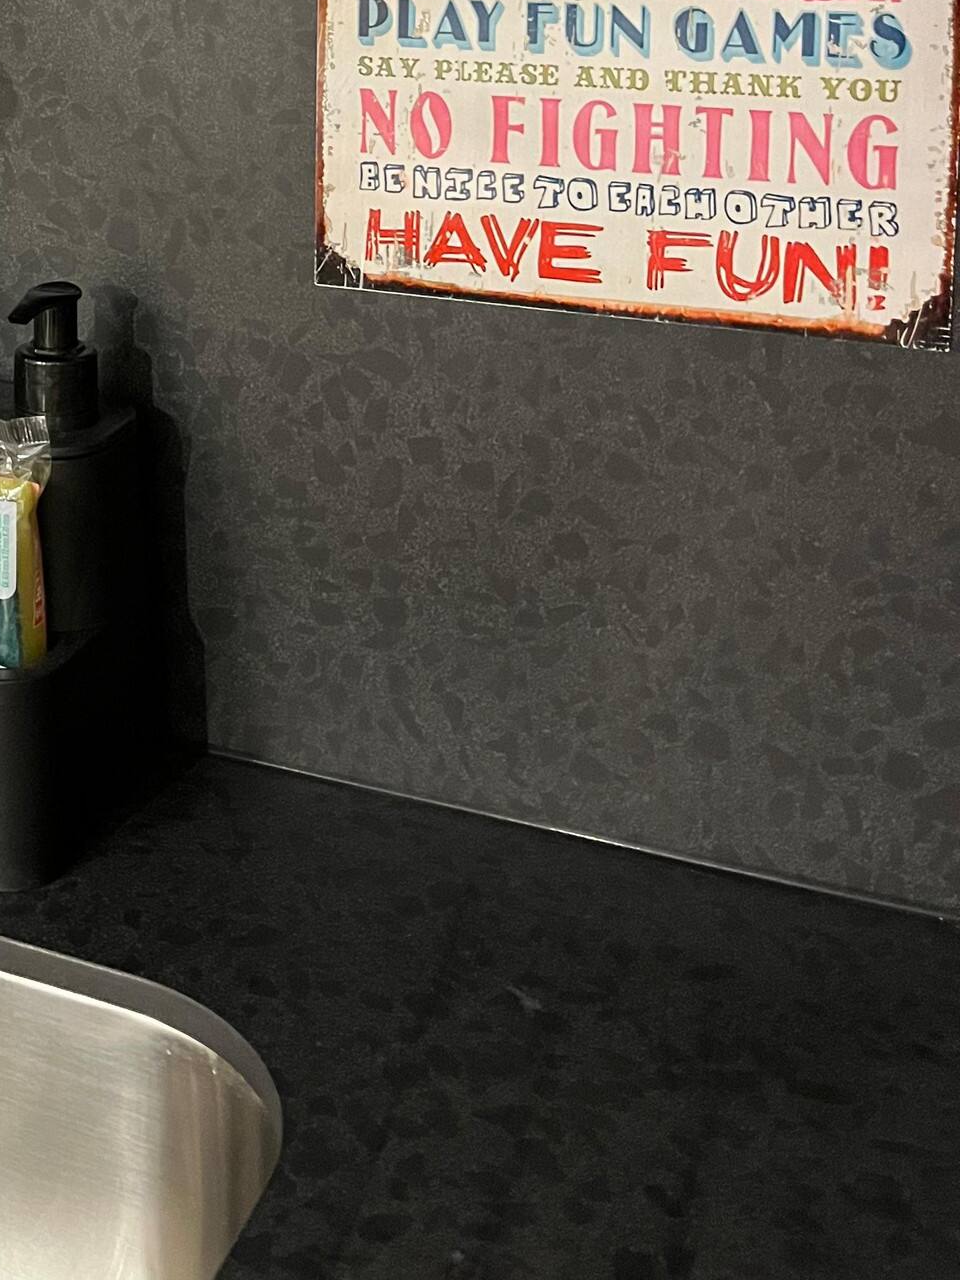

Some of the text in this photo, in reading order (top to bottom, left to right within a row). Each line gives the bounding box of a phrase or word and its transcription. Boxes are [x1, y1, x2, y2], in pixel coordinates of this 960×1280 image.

[526, 0, 651, 60] FUN
[673, 5, 913, 70] GAMES
[357, 55, 902, 103] SAY PLEASE AND THANK YOU
[359, 88, 900, 192] NO FIGHTING
[359, 161, 900, 237] BE NICE TO EACH OTHER
[365, 208, 889, 311] HAVE FUN!
